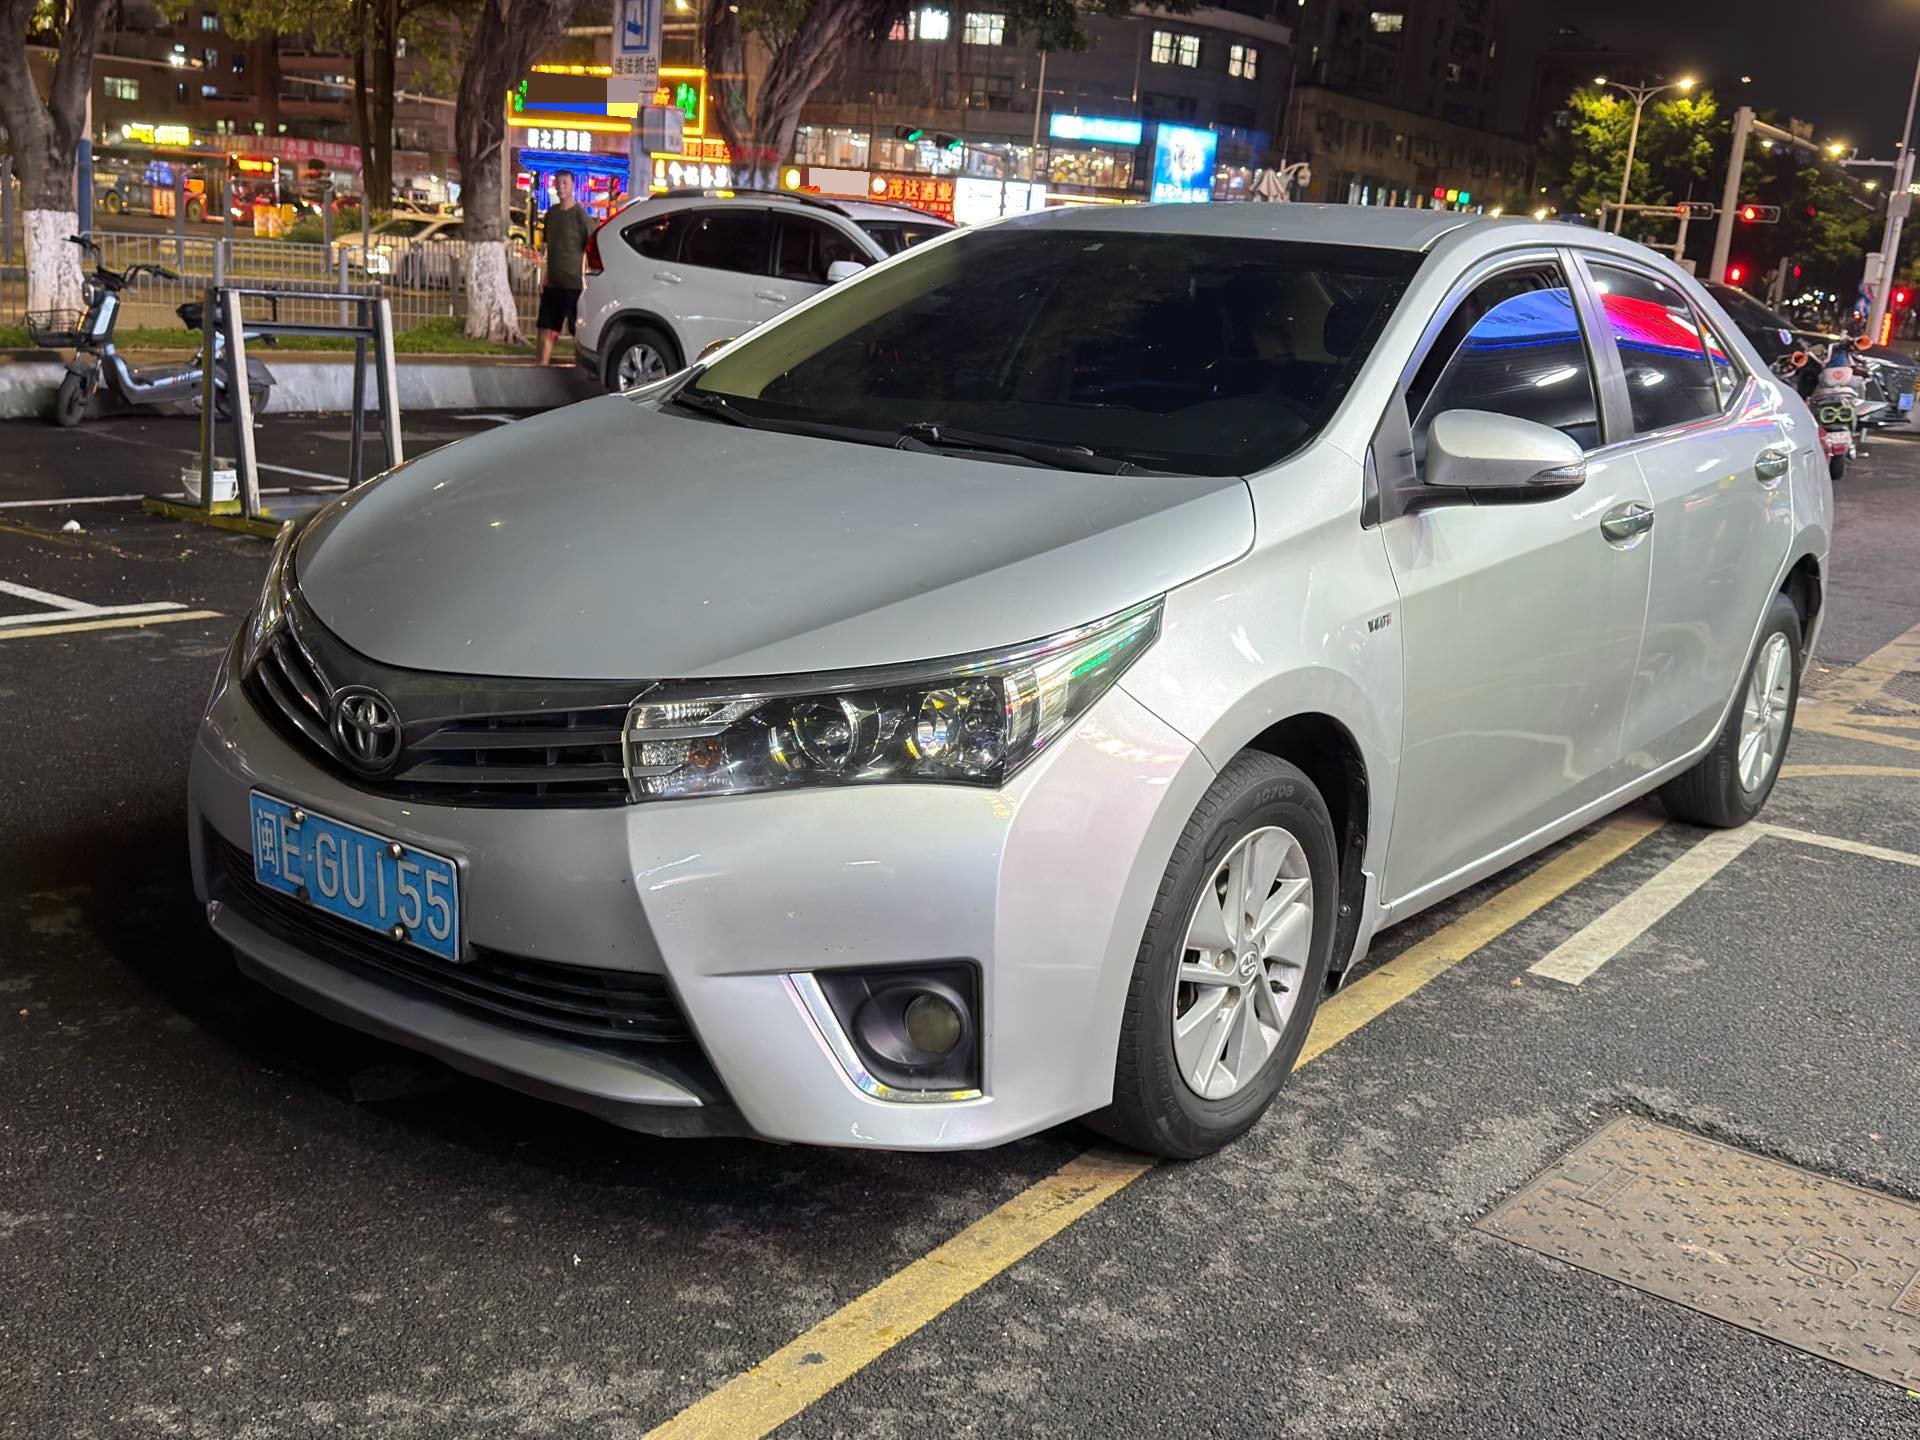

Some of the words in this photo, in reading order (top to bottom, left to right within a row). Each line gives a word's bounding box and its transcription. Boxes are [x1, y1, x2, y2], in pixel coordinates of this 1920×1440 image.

[615, 56, 657, 75] 违法抓拍
[888, 178, 953, 203] 茂达酒业
